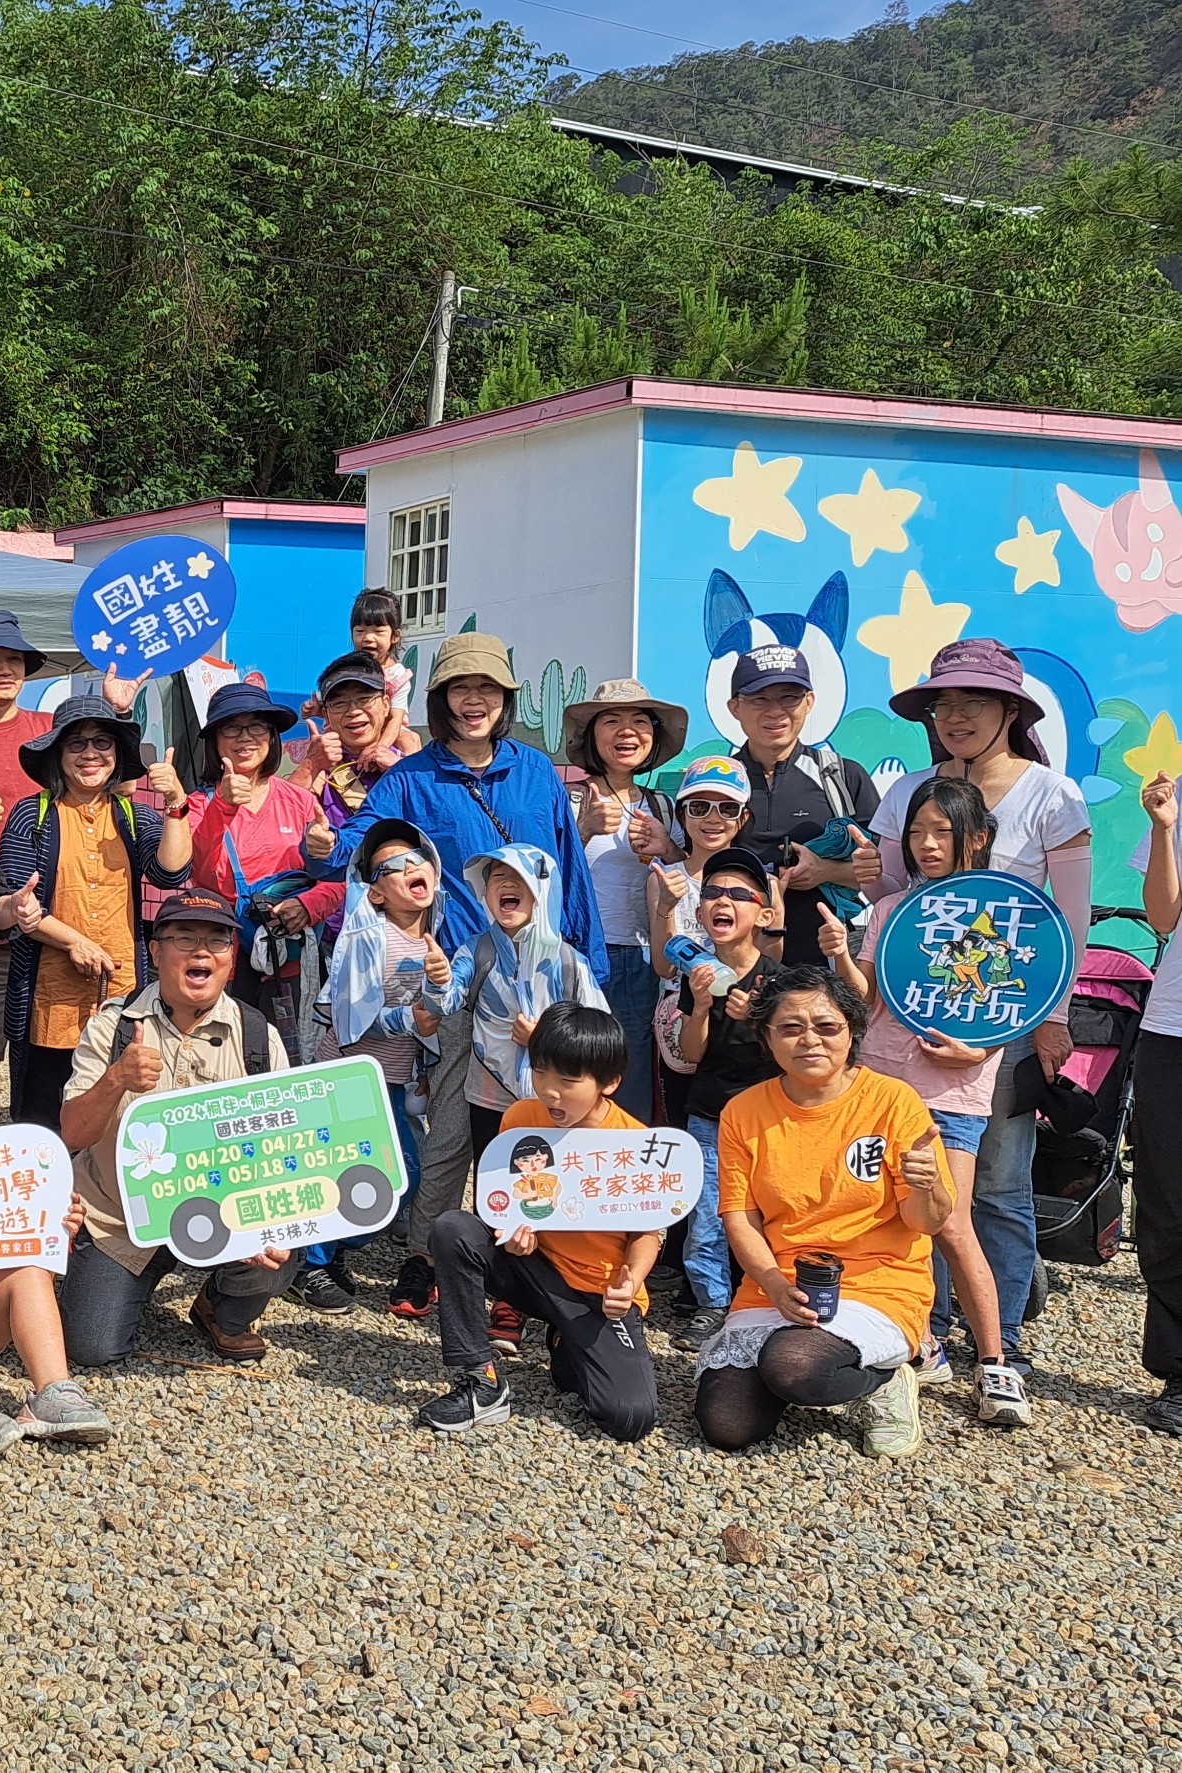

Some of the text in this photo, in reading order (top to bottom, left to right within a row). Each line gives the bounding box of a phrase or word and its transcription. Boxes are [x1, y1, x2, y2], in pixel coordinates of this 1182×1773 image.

[92, 559, 183, 626] 國姓
[129, 591, 219, 660] 盡靚
[914, 891, 1044, 951] 客庄
[903, 979, 1027, 1028] 好好玩
[216, 1110, 297, 1138] 國姓客家庄
[151, 1173, 208, 1200] 05/04
[228, 1159, 284, 1184] 05/18
[304, 1143, 358, 1169] 05/25
[185, 1145, 242, 1172] 04/20
[261, 1130, 315, 1156] 04/27
[850, 1138, 884, 1178] 悟
[235, 1180, 325, 1226] 國姓鄉
[579, 1171, 684, 1199] 客家粢粑
[598, 1200, 663, 1215] 客家DIY體驗
[259, 1220, 321, 1246] 共5梯次
